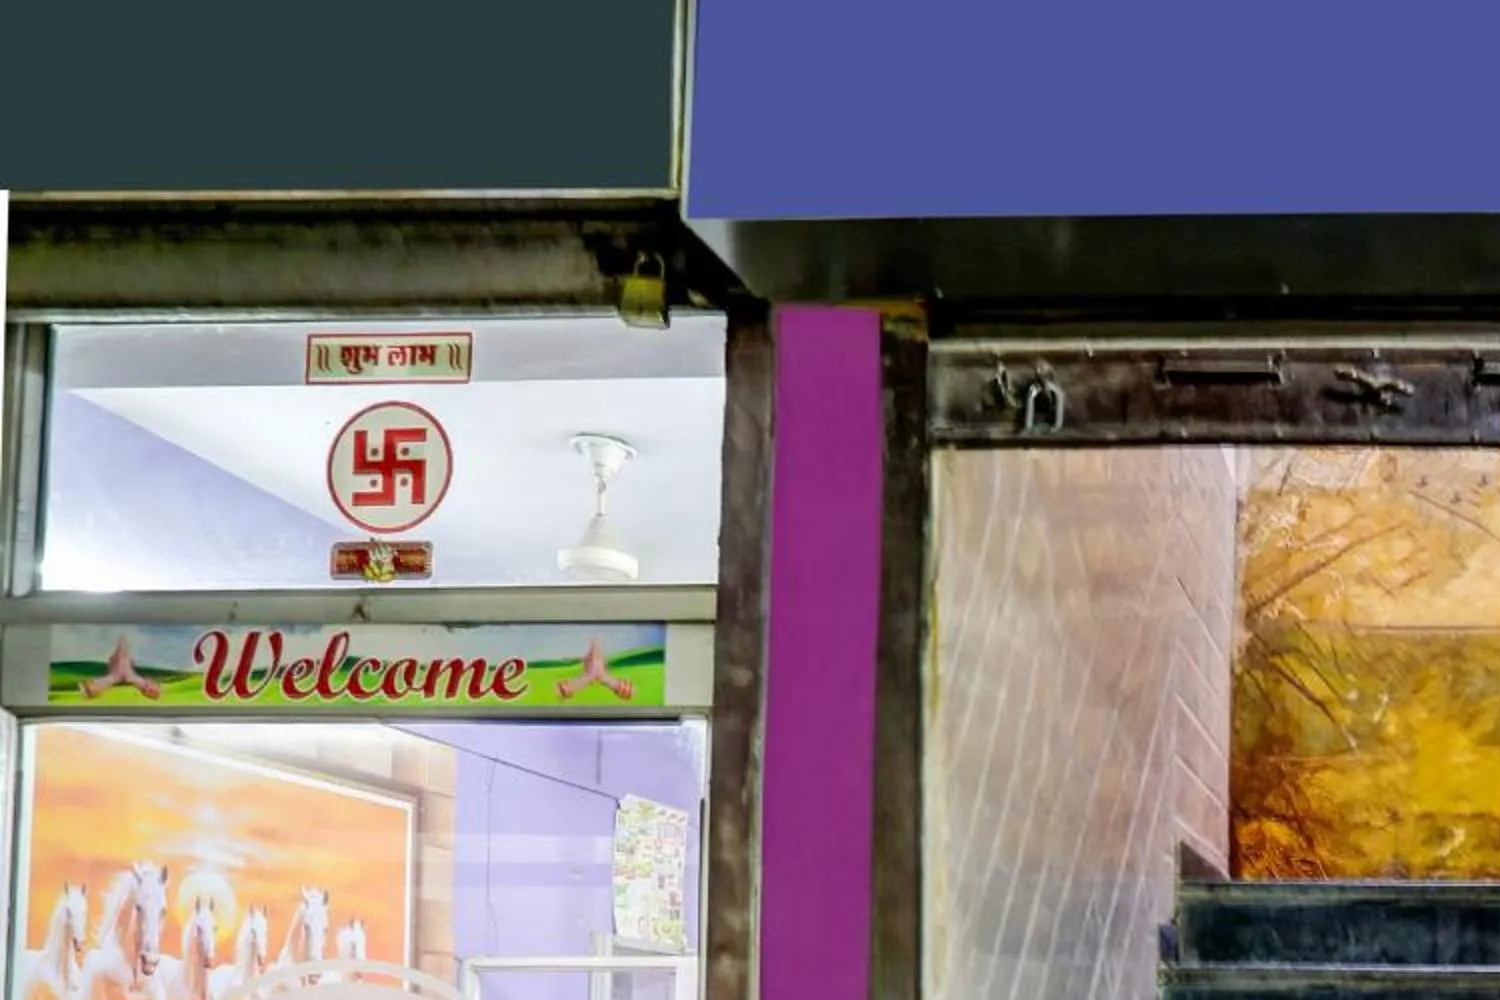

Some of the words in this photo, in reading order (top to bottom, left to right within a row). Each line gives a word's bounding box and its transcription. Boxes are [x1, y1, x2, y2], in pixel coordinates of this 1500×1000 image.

[340, 345, 381, 375] शुभ
[386, 343, 438, 367] लाभ
[193, 630, 529, 700] Welcome
